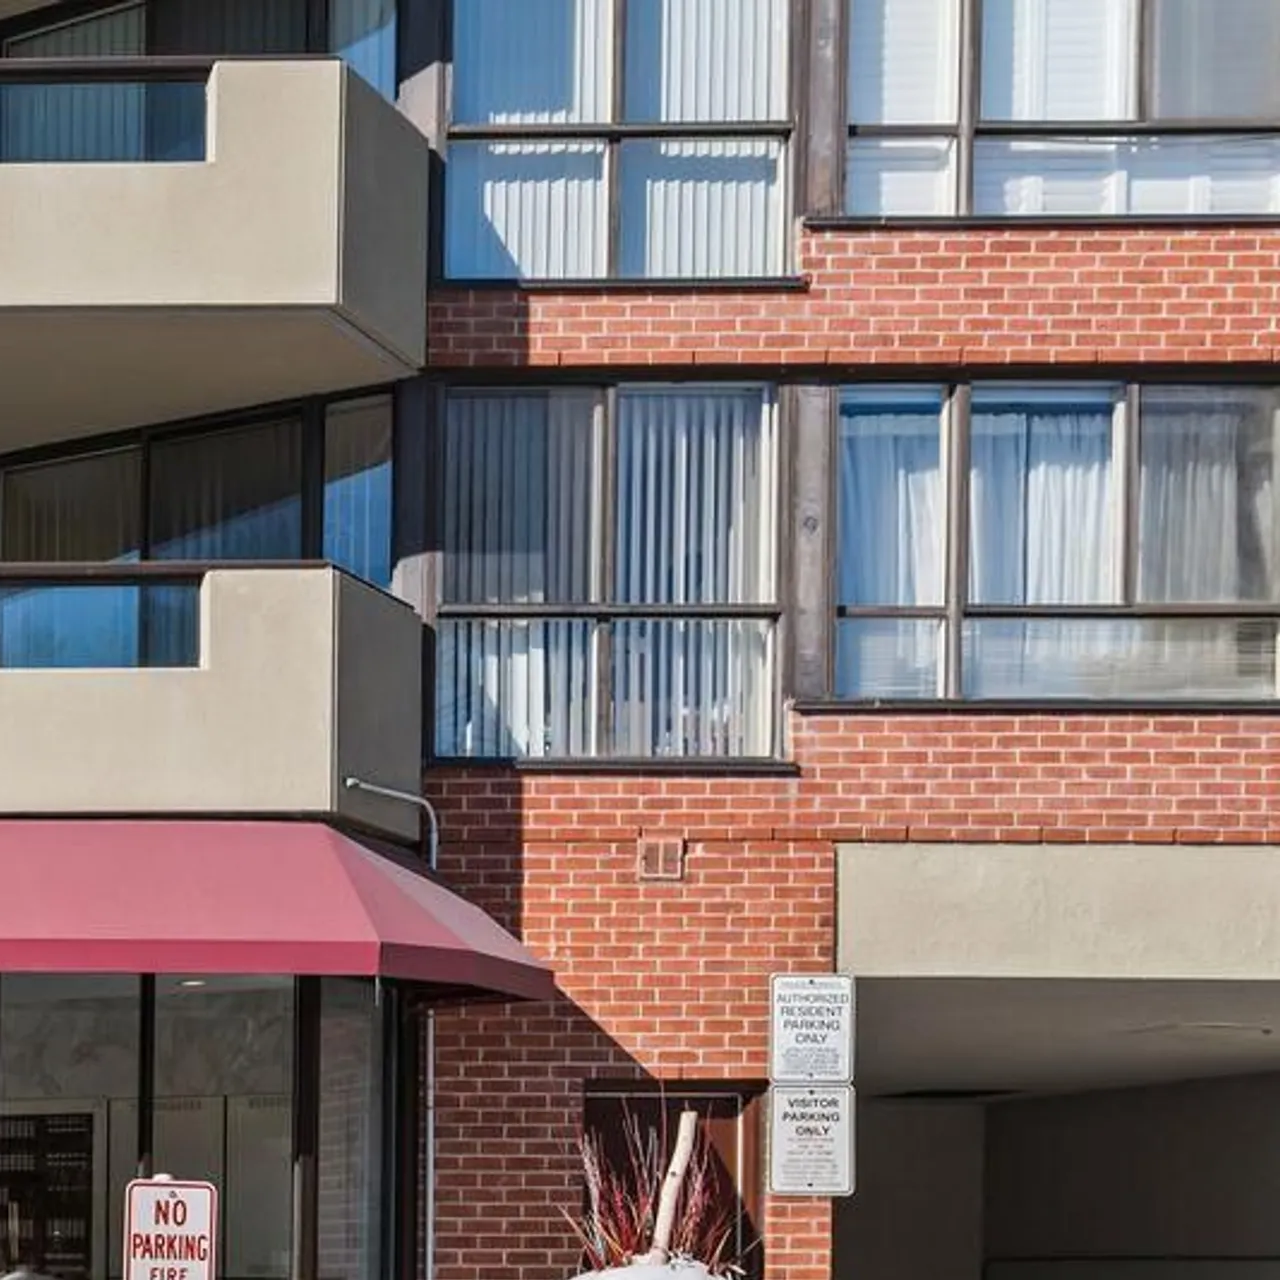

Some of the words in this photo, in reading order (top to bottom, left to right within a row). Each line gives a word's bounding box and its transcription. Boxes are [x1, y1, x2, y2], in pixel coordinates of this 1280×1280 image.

[780, 1006, 843, 1017] RESIDENT
[782, 1019, 840, 1031] PARKING
[795, 1032, 828, 1044] ONLY
[787, 1097, 840, 1109] VISITOR
[782, 1111, 841, 1122] PARKING
[794, 1125, 830, 1137] ONLY
[154, 1199, 188, 1226] NO
[132, 1232, 208, 1262] PARKING
